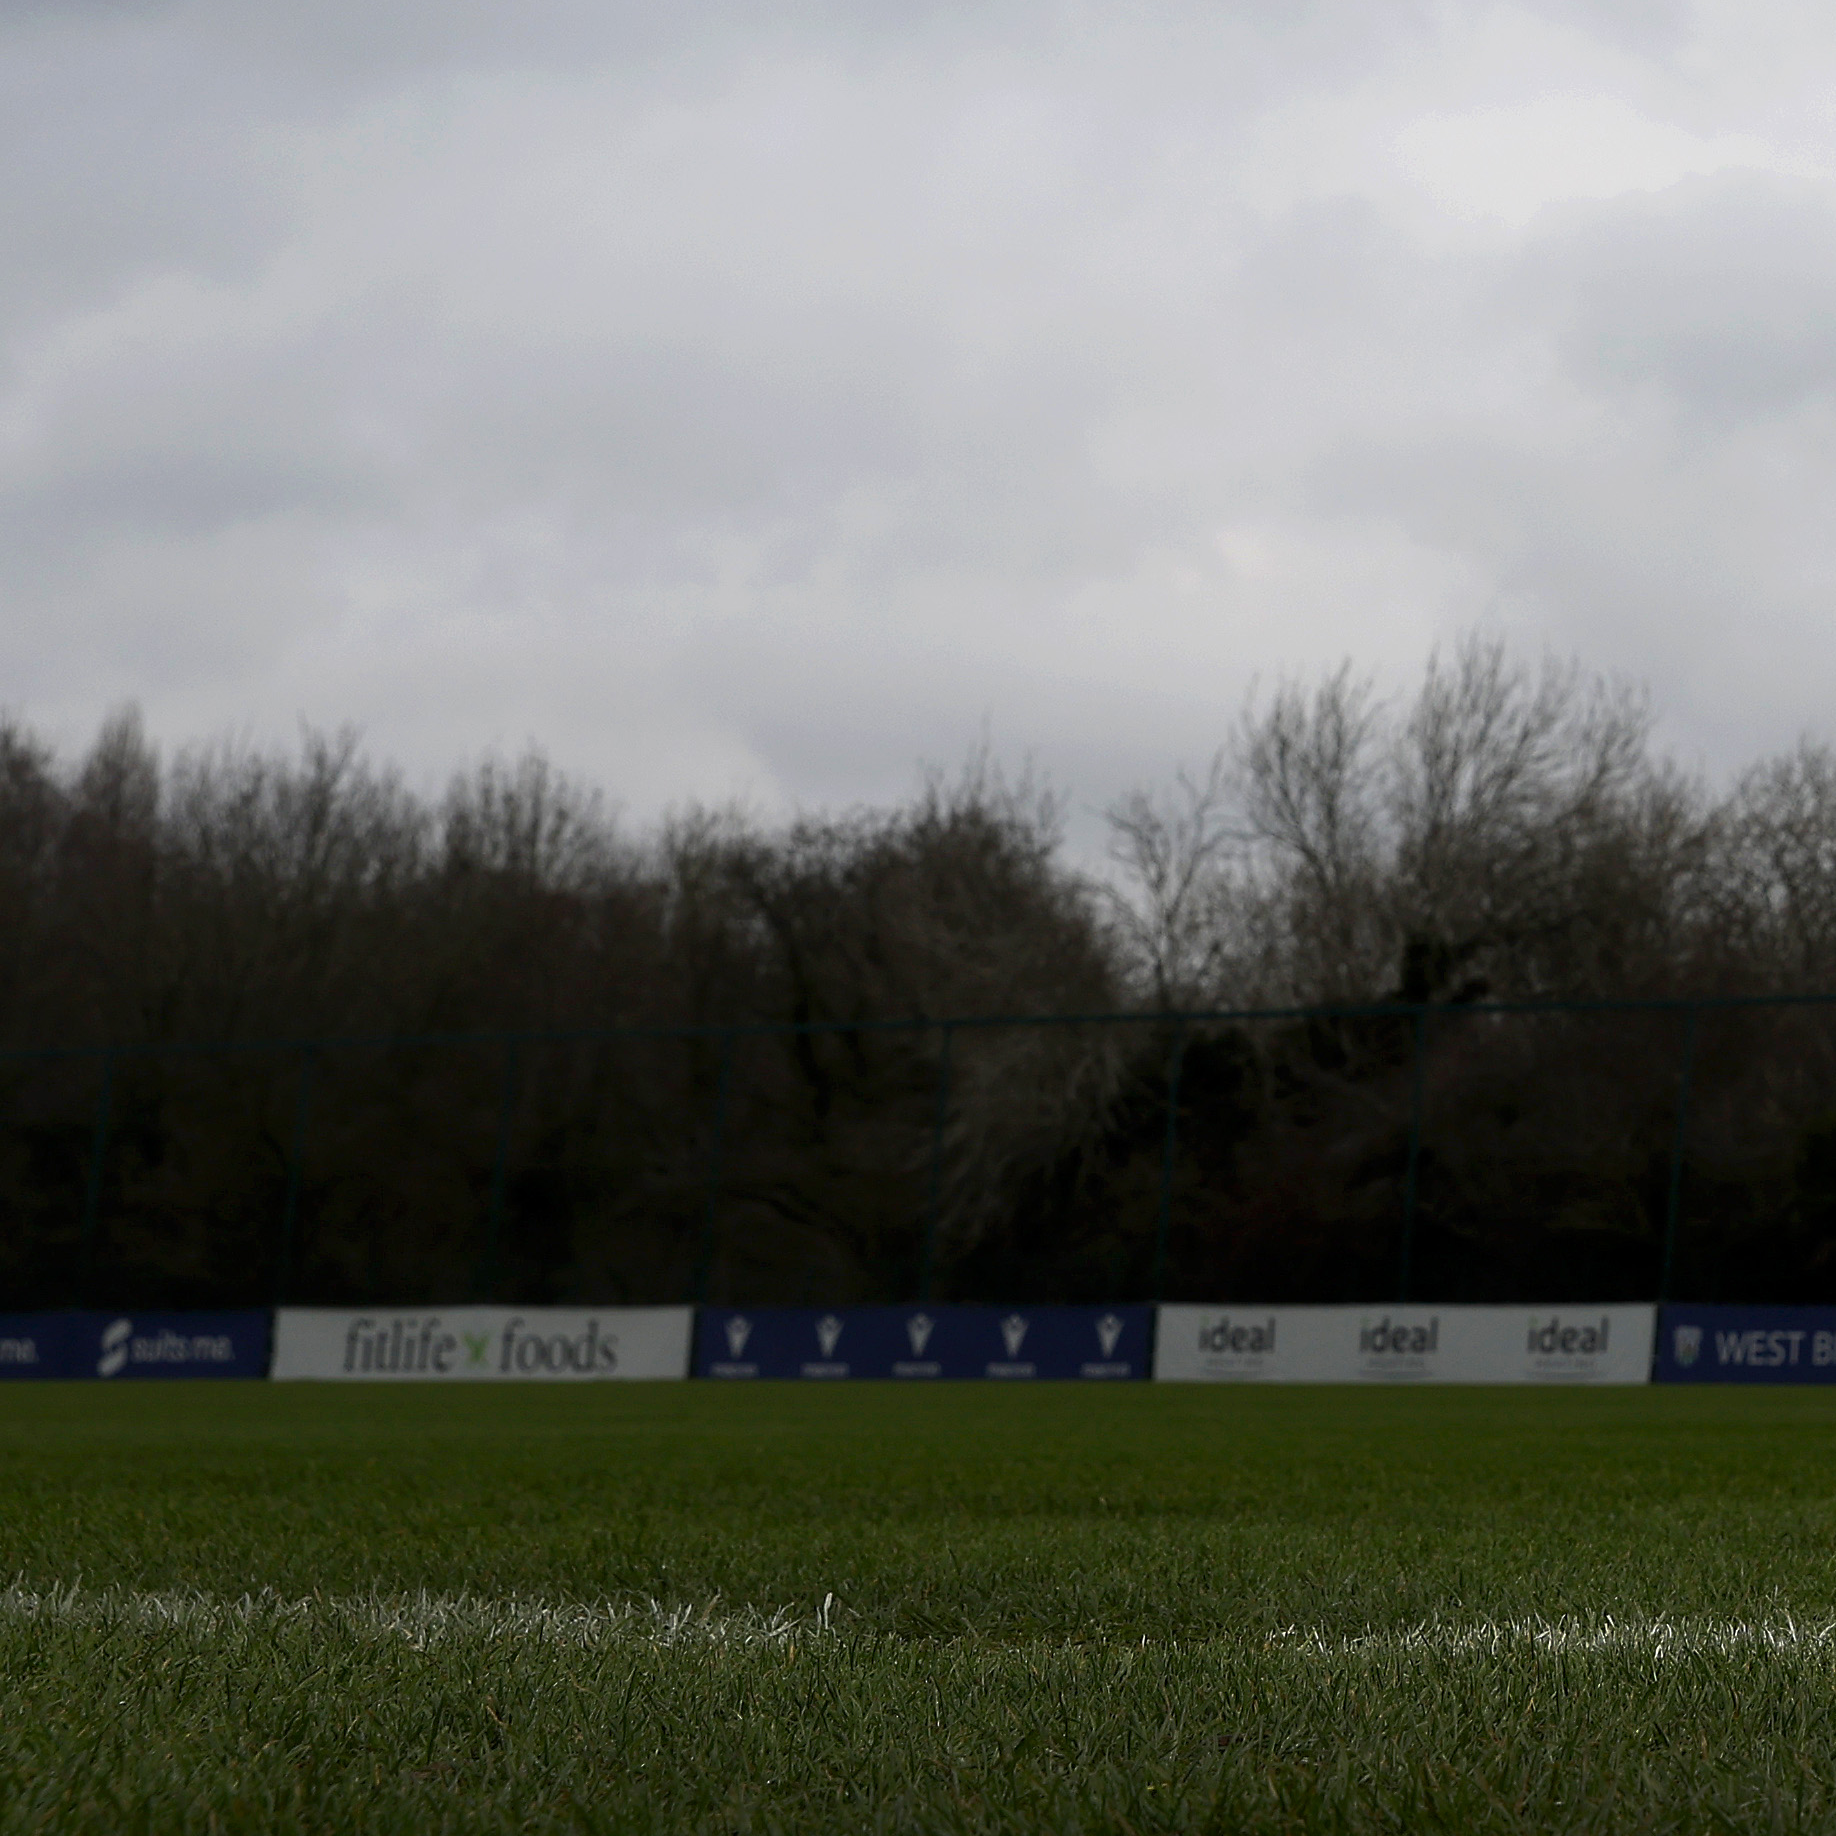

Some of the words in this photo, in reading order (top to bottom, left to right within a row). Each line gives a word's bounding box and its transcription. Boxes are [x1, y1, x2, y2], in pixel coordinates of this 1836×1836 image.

[343, 1318, 456, 1374] fitlife
[499, 1318, 619, 1375] foods
[1199, 1315, 1276, 1355] ideal
[1360, 1315, 1439, 1355] ideal
[1527, 1314, 1609, 1355] ideal
[1715, 1330, 1806, 1365] WEST
